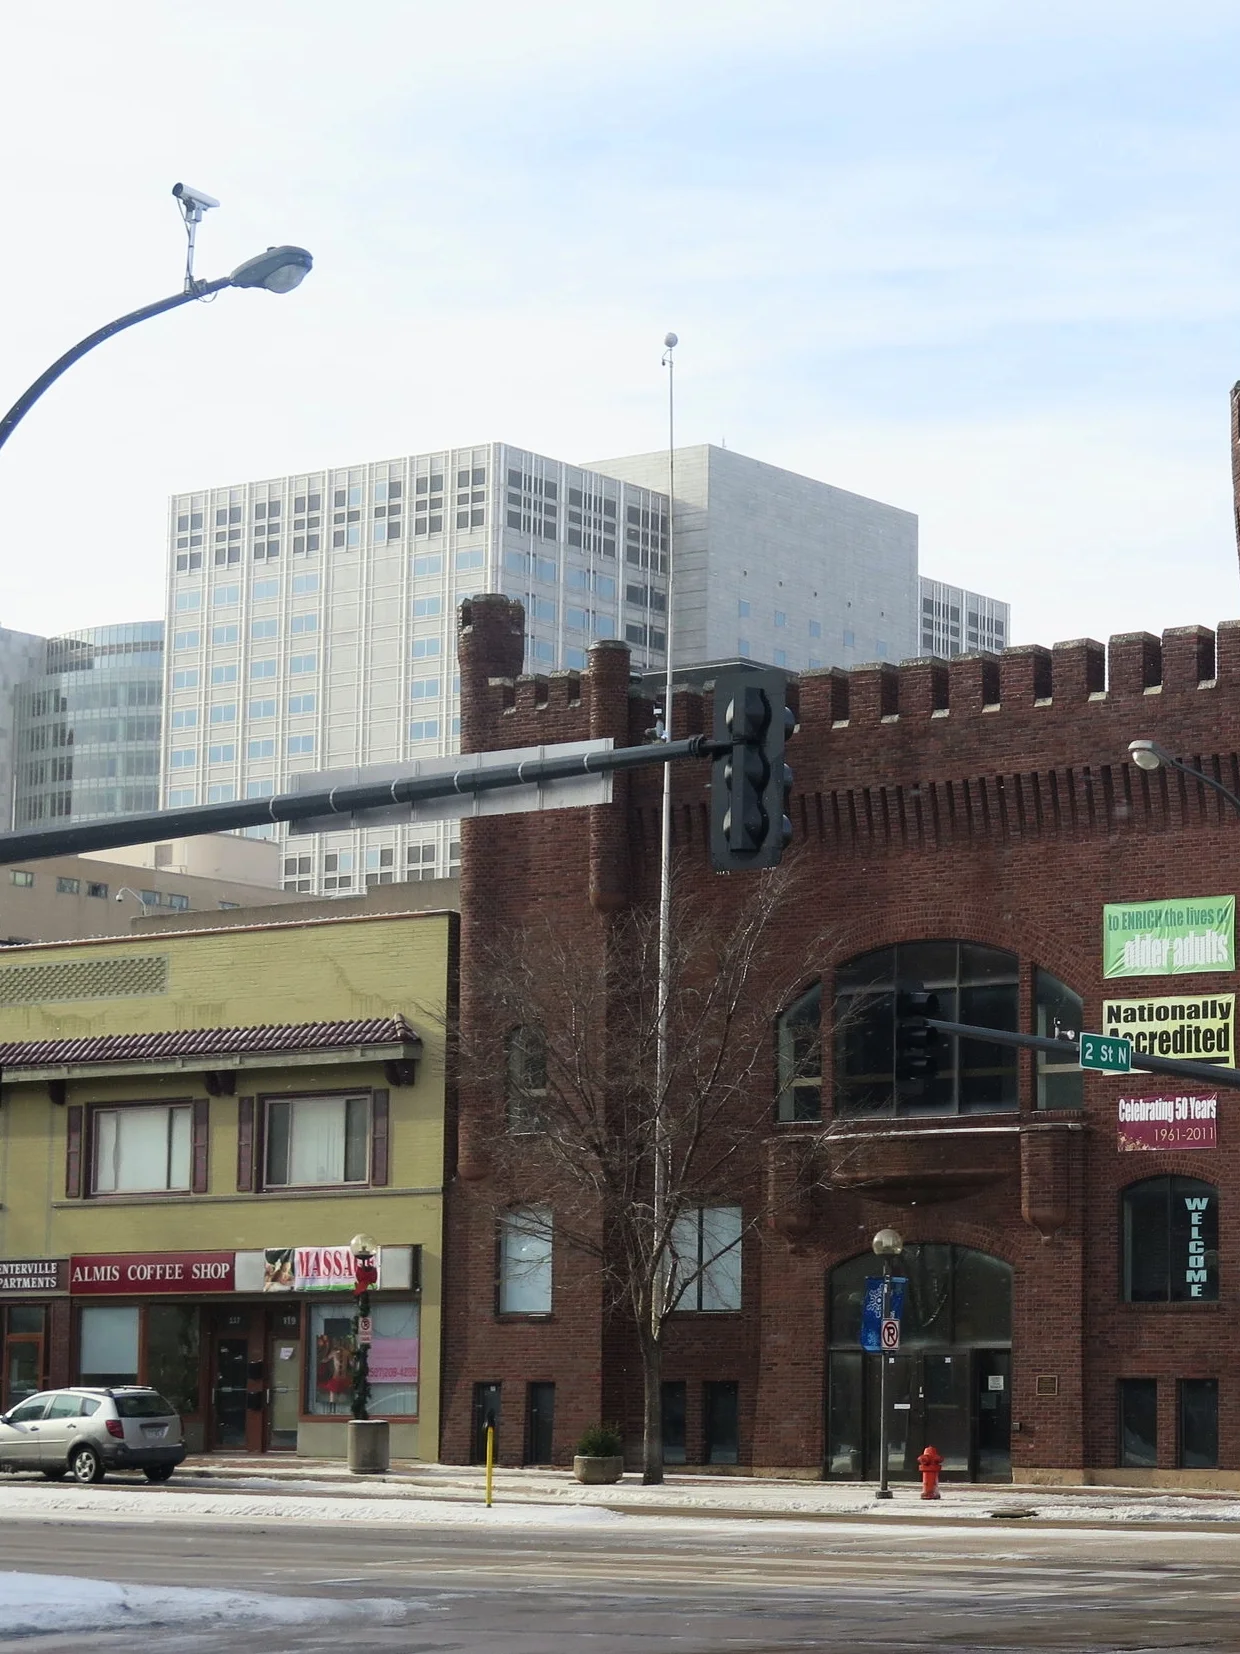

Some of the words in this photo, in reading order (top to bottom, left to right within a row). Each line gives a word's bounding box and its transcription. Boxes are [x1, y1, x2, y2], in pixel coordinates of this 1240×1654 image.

[1108, 913, 1119, 931] to
[1164, 907, 1184, 927] the
[1186, 906, 1214, 926] lives
[1173, 930, 1228, 966] adults
[1107, 1000, 1232, 1024] Nationally
[1084, 1043, 1094, 1060] 2
[1100, 1044, 1113, 1063] St
[1118, 1046, 1127, 1064] N
[1118, 1098, 1174, 1123] Celebrating
[1175, 1096, 1188, 1120] 50
[1189, 1096, 1217, 1120] Years
[1154, 1127, 1213, 1142] 1961-2011
[1184, 1197, 1209, 1297] WELCOME
[72, 1265, 120, 1282] ALMIS
[127, 1263, 184, 1281] COFFEE
[191, 1262, 230, 1280] SHOP
[298, 1250, 376, 1277] MASSA
